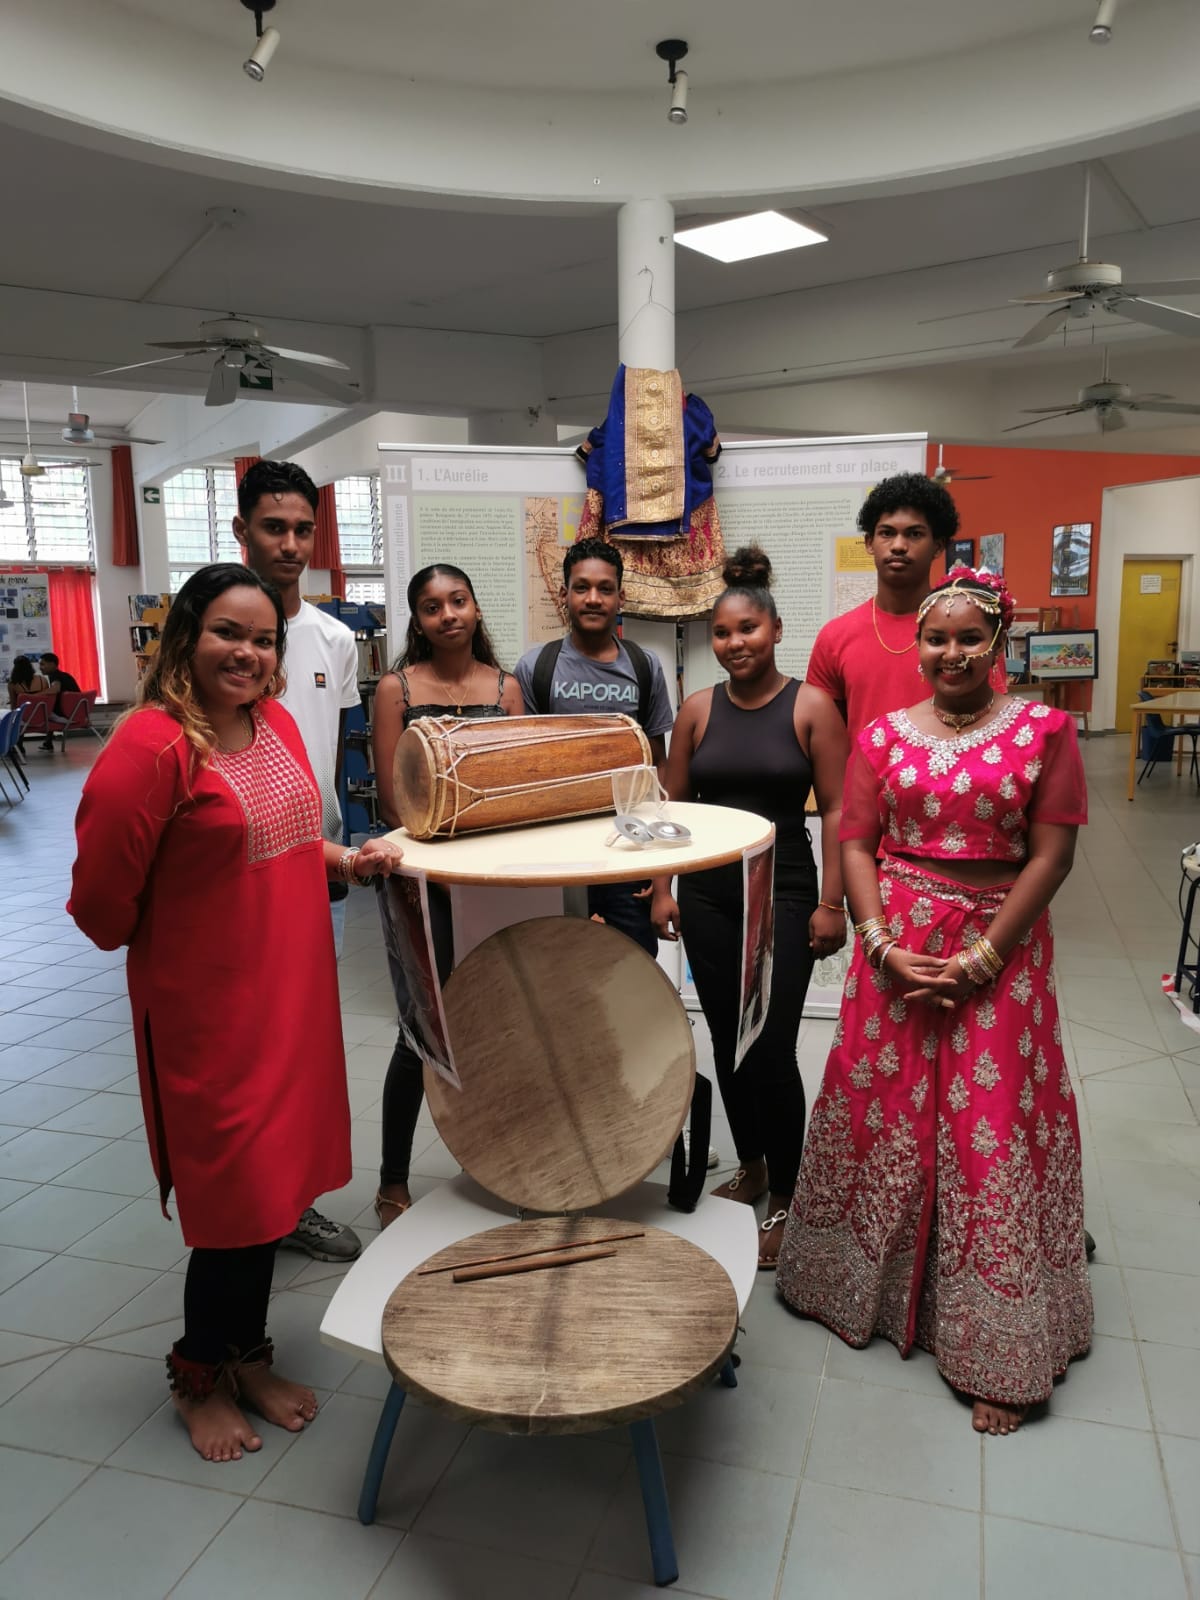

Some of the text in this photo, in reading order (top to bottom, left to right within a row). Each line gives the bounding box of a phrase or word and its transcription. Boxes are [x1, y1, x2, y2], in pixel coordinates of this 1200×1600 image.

[418, 466, 489, 482] 1. L'Aurélie
[718, 459, 898, 479] 2. Le recrutement sur place
